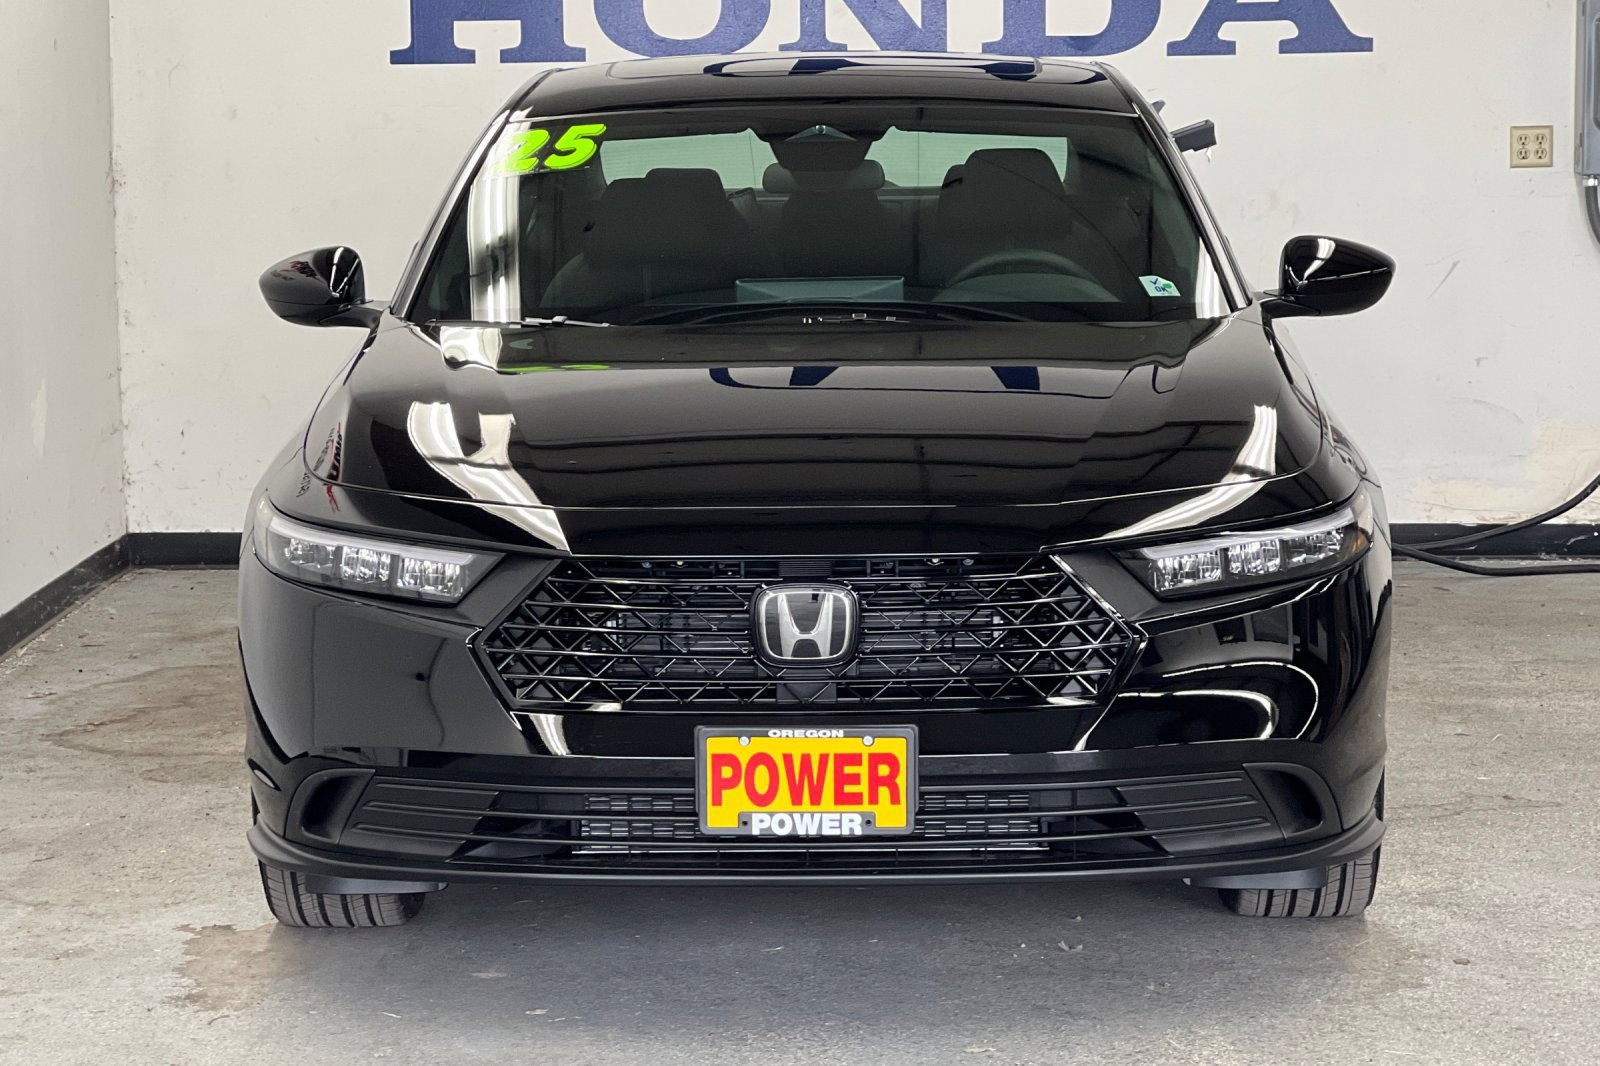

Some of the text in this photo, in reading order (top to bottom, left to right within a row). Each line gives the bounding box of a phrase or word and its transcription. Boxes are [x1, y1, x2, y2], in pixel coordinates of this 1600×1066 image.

[497, 123, 607, 173] 25
[767, 729, 844, 738] OREGON
[711, 752, 901, 807] POWER
[751, 812, 863, 836] POWER
